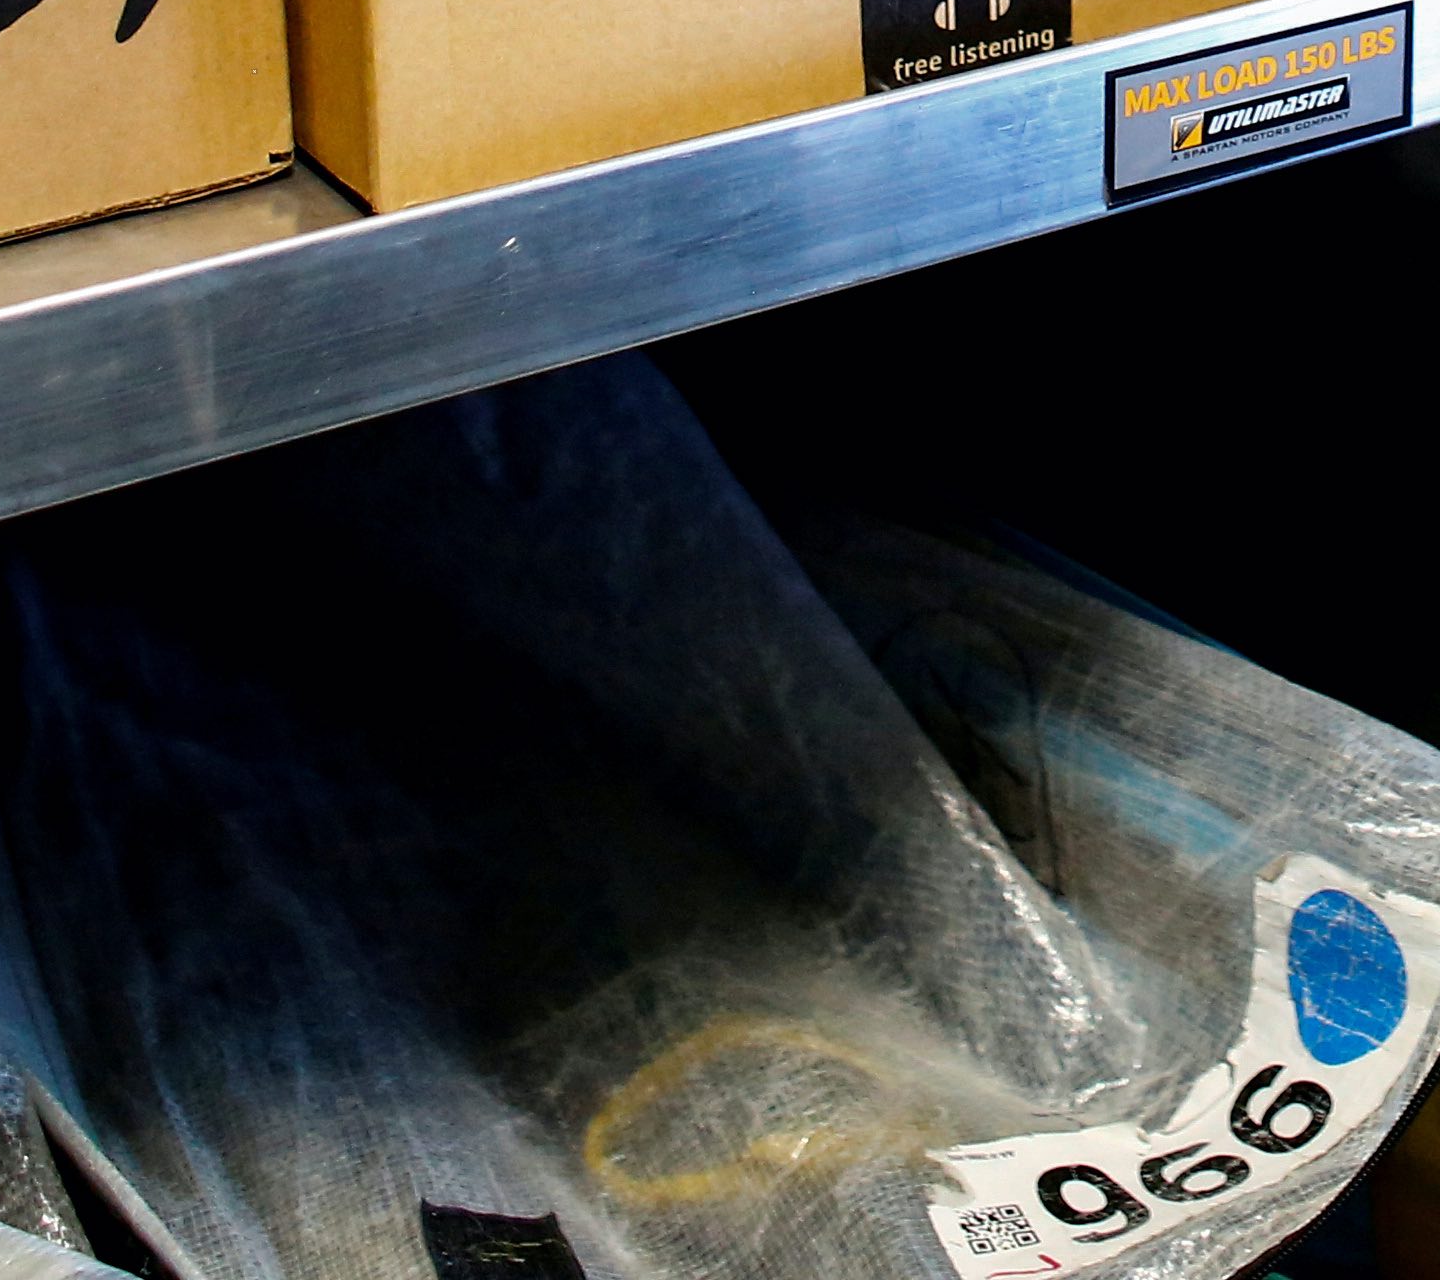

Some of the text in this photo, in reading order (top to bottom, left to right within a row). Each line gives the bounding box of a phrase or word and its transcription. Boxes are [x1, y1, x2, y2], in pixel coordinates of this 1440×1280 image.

[893, 27, 1056, 82] free listening
[1123, 26, 1397, 119] MAX LOAD 150 LBS
[1171, 111, 1351, 162] A SPARTAN MOTORS COMPANY
[1207, 83, 1345, 136] UTILIMASTER
[1035, 1063, 1335, 1243] 966
